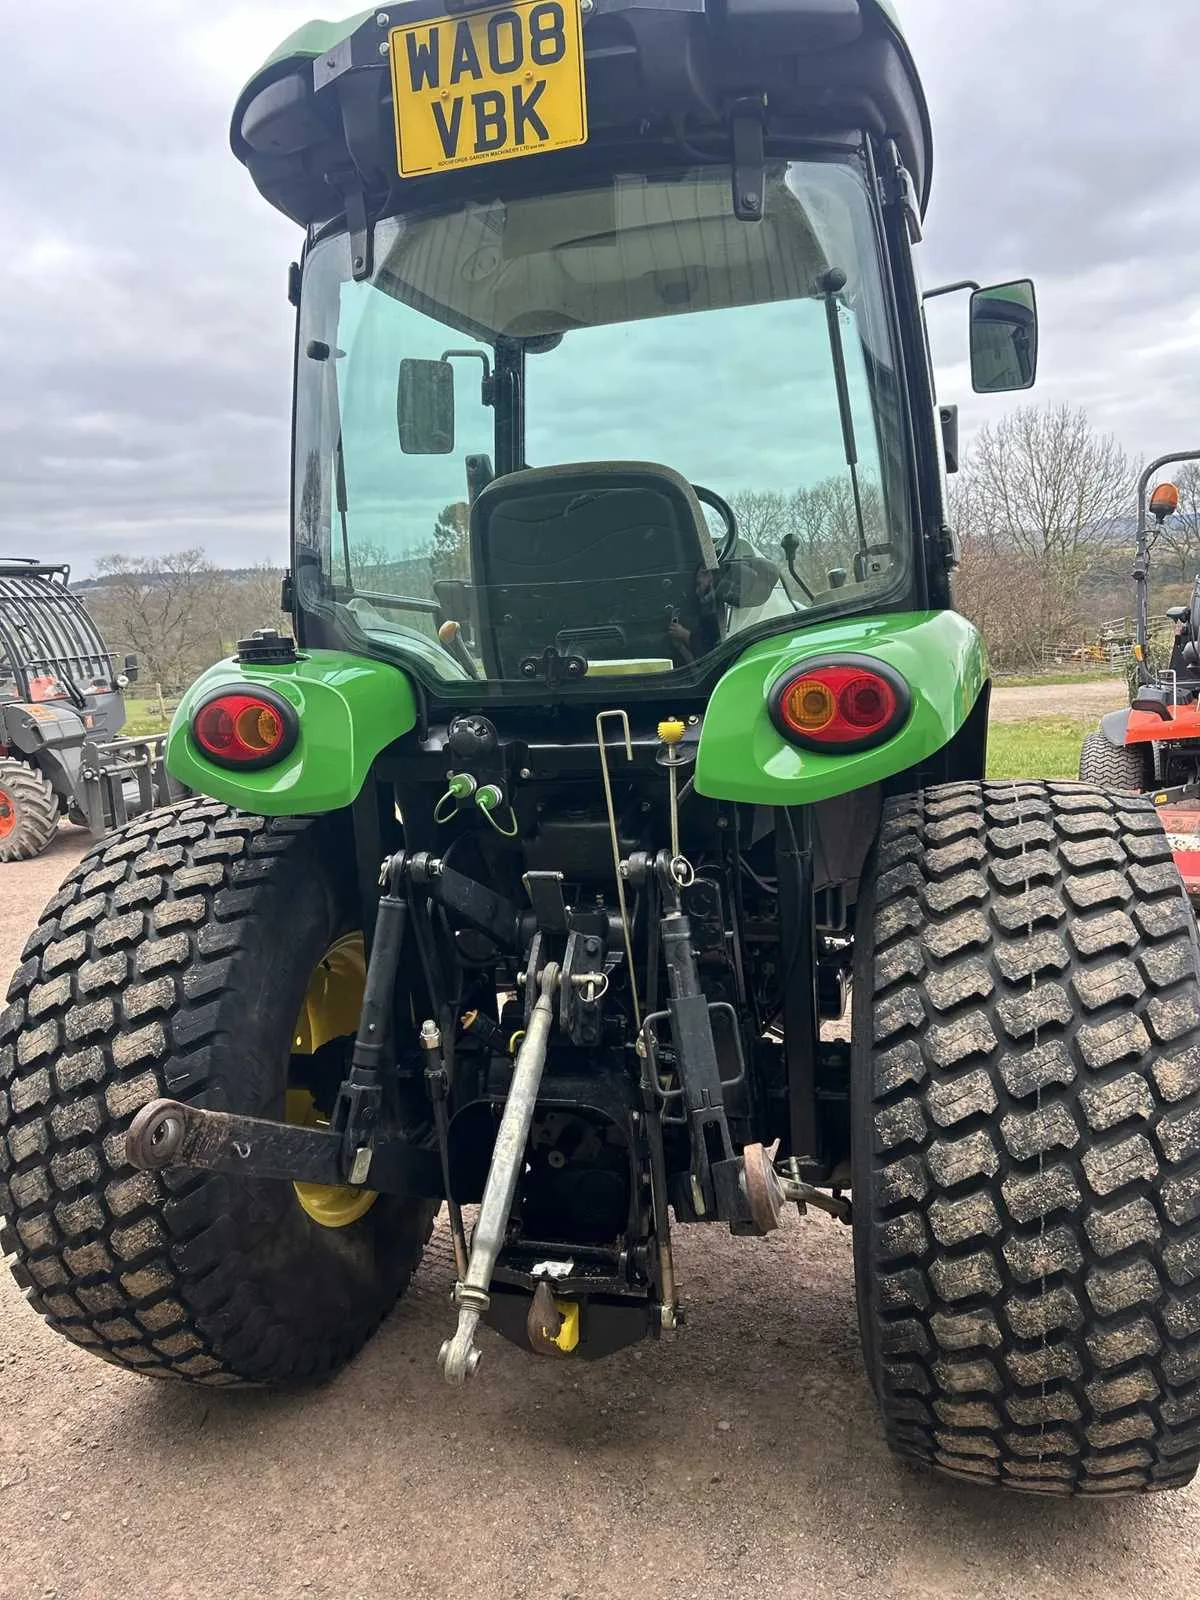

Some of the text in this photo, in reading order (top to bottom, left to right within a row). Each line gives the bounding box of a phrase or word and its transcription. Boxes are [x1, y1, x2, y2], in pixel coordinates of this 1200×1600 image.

[405, 2, 566, 92] WA08
[431, 79, 550, 158] VBK
[469, 153, 490, 161] GARDEN
[490, 147, 519, 158] MACHINERY
